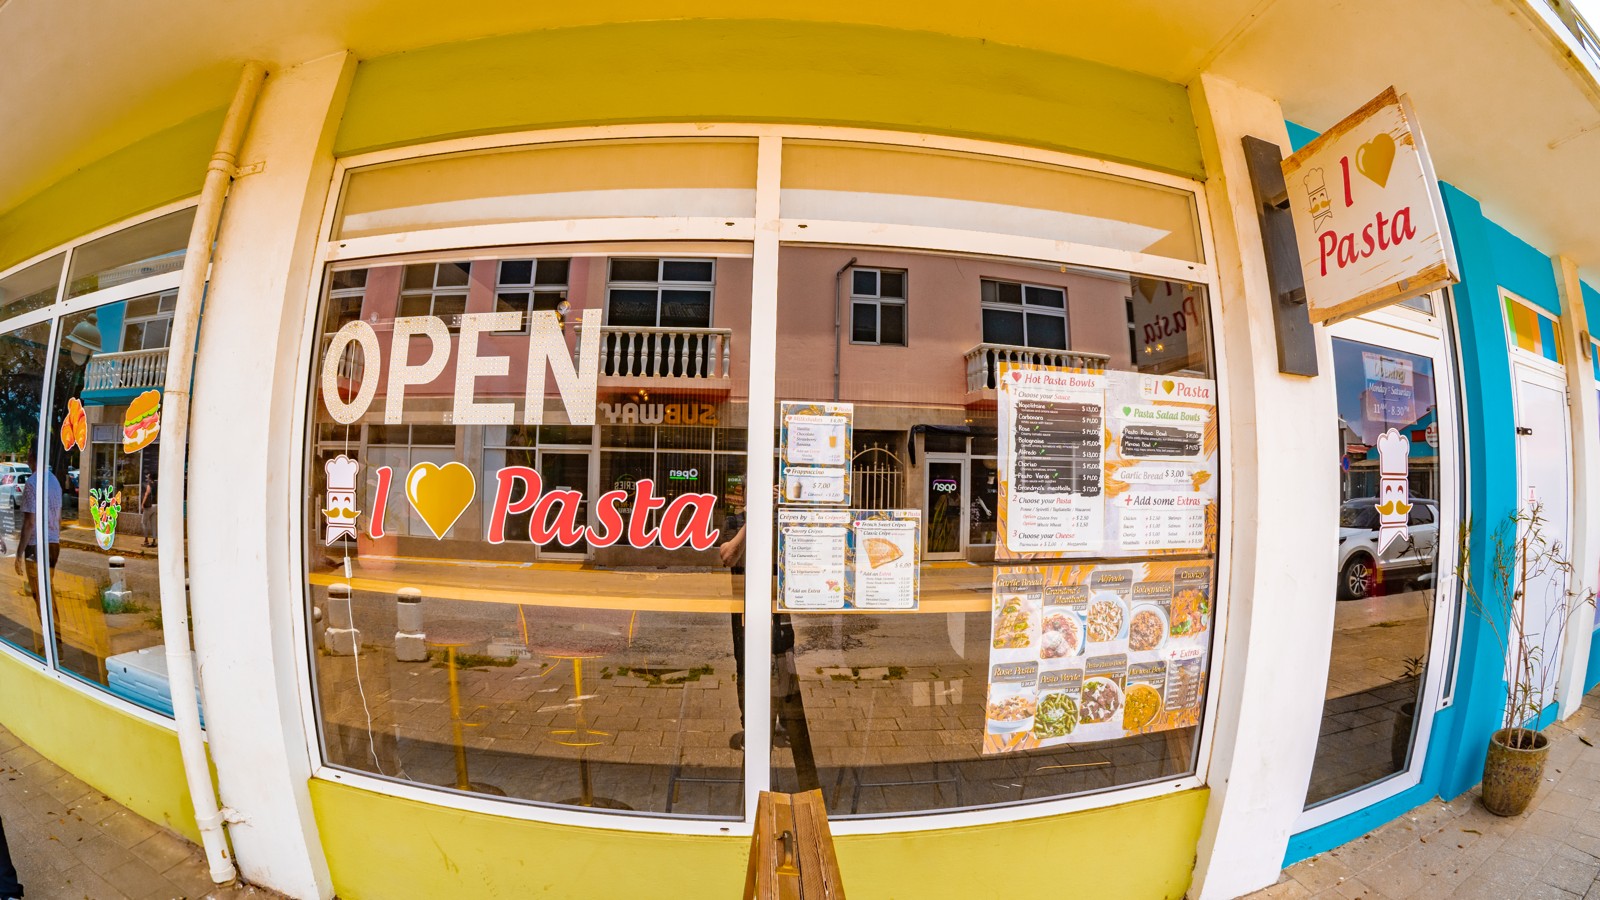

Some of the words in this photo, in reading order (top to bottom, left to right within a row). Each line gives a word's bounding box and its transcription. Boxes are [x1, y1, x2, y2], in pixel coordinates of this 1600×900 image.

[1340, 156, 1353, 207] I
[1318, 206, 1416, 277] Pasta
[321, 308, 602, 426] OPEN
[1025, 373, 1041, 384] Hot
[1043, 375, 1067, 386] Pasta
[1069, 377, 1095, 388] Bowls
[1018, 391, 1038, 399] Choose
[1054, 393, 1071, 401] Sauce
[1154, 380, 1158, 394] I
[1177, 382, 1209, 399] Pasta
[1369, 383, 1387, 396] Monday
[1391, 385, 1411, 399] Saturday
[1134, 408, 1154, 418] Pasta
[1155, 410, 1179, 420] Salad
[1180, 411, 1200, 421] Bowls
[1120, 470, 1142, 480] Garlic
[1143, 472, 1164, 480] Bread
[1041, 498, 1055, 506] your
[1133, 495, 1151, 506] Add
[1152, 498, 1175, 506] some
[1177, 496, 1200, 506] Extras
[370, 466, 391, 539] I
[487, 466, 720, 550] Pasta
[1098, 574, 1125, 583] Alfredo
[1180, 649, 1200, 658] Extras
[994, 667, 1012, 677] Rose
[1014, 666, 1035, 675] Pasta
